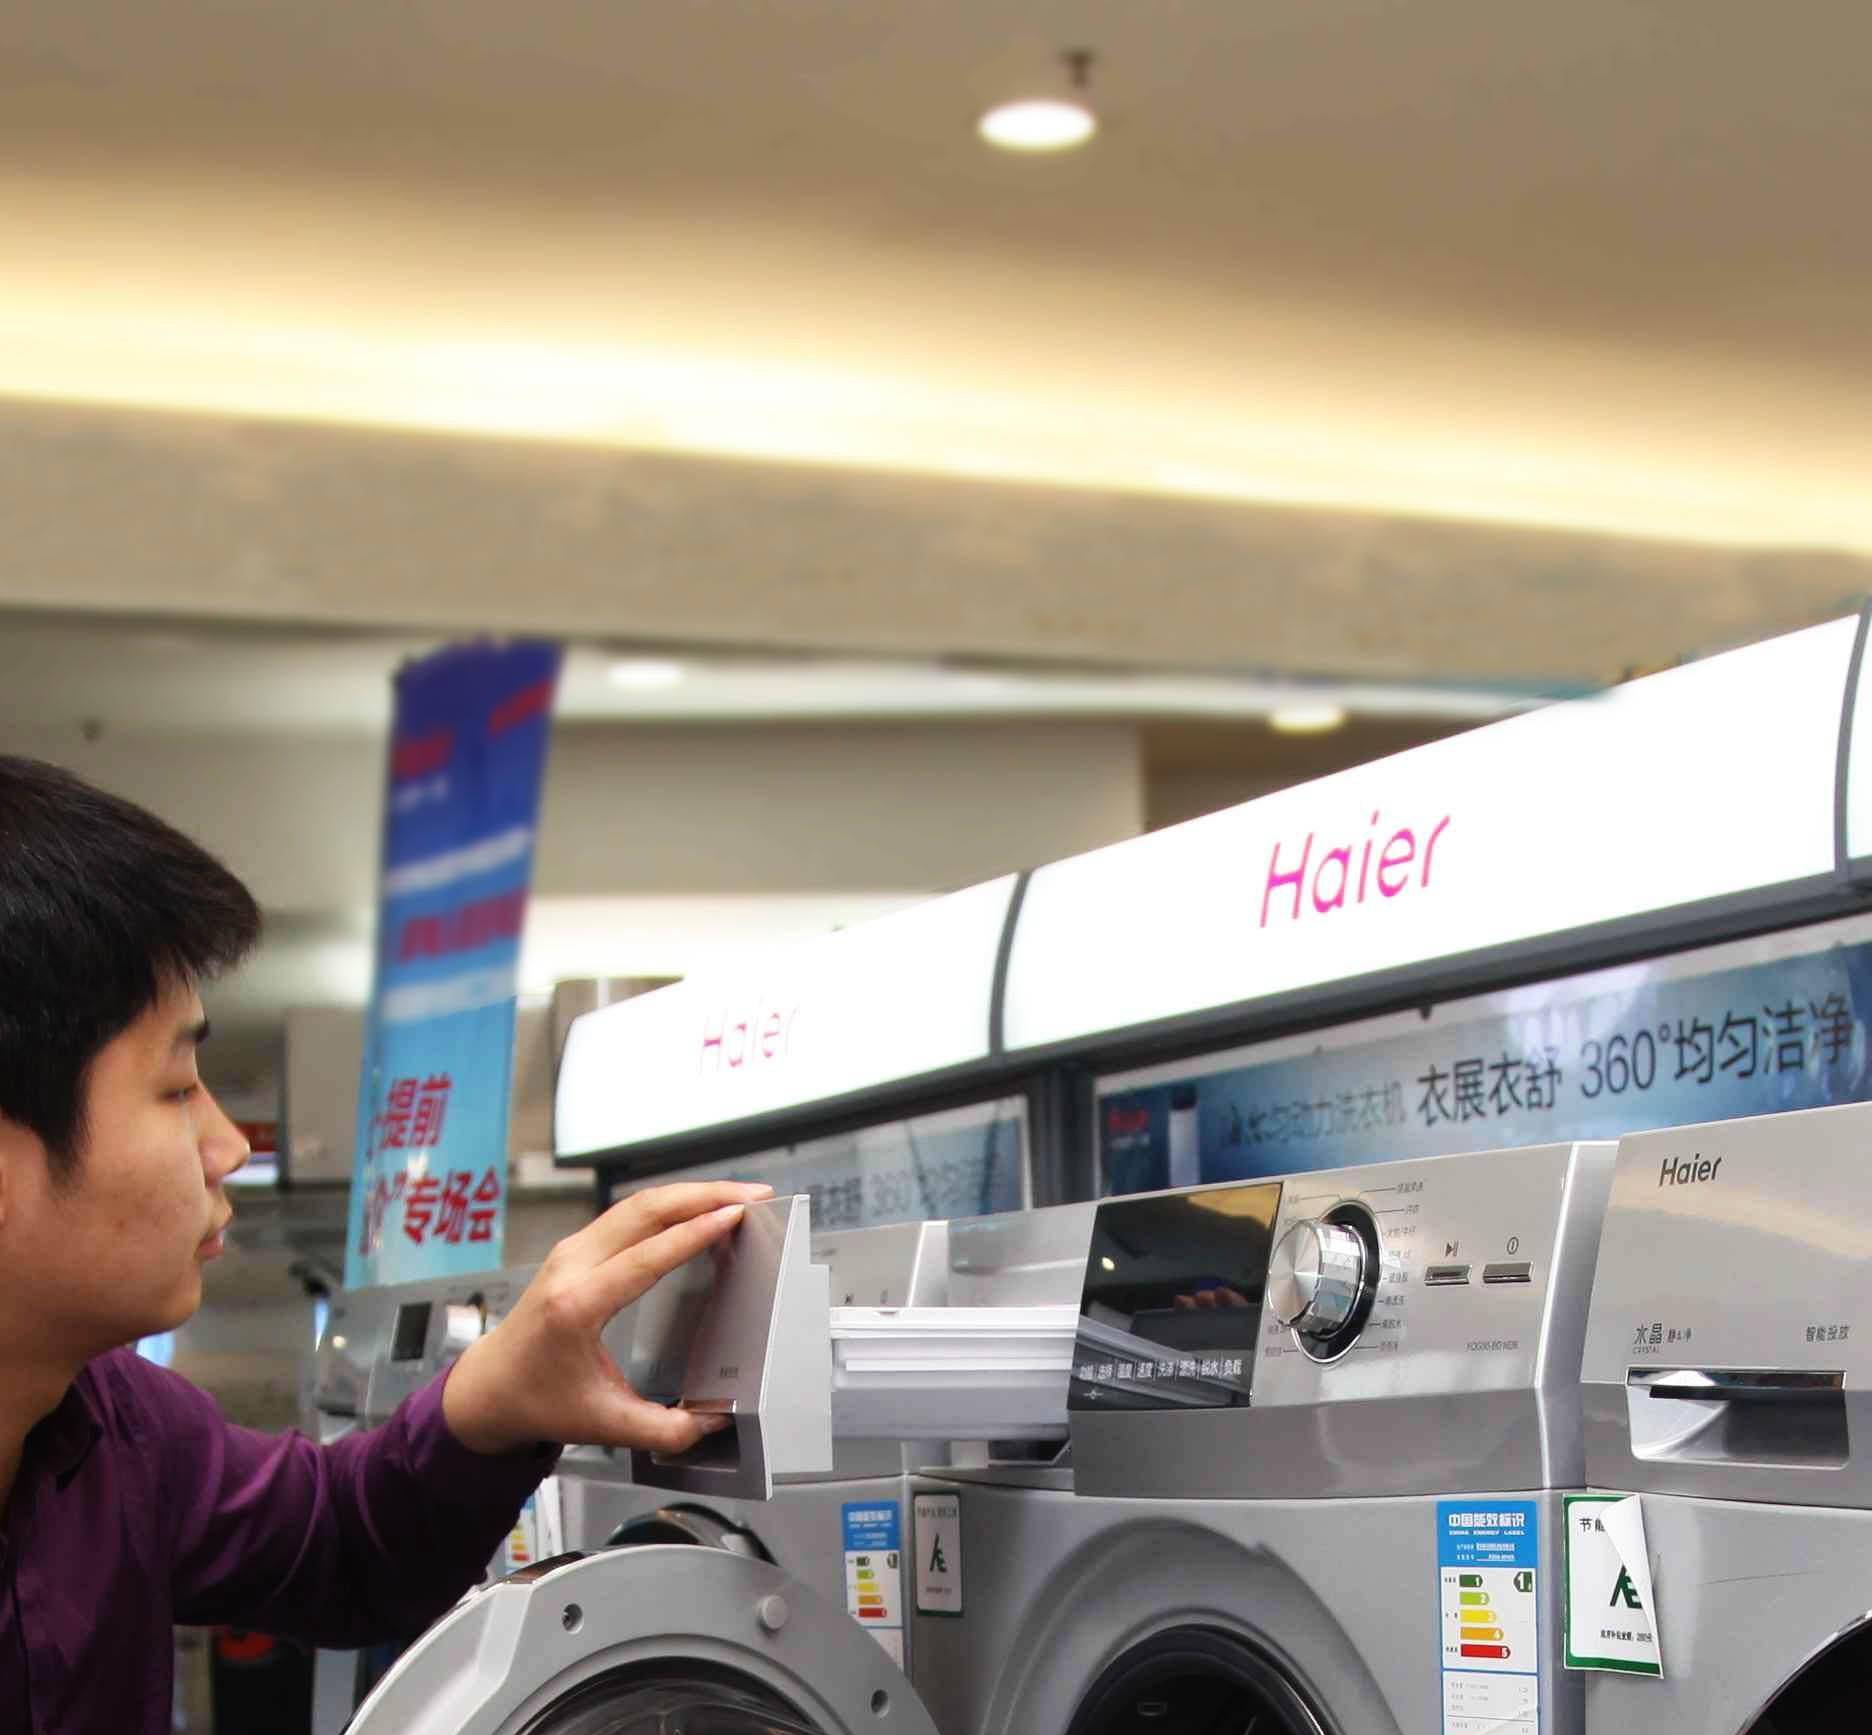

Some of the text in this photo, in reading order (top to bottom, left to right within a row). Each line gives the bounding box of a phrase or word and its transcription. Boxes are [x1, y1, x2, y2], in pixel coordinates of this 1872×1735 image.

[1259, 810, 1452, 929] Haier
[697, 1003, 801, 1075] Haier
[1416, 1045, 1564, 1129] 衣展衣舒
[1580, 992, 1855, 1102] 360°均匀洁净
[1659, 1153, 1722, 1187] Haier
[1633, 1323, 1663, 1346] 水晶
[1448, 1512, 1526, 1528] 中国能效标识
